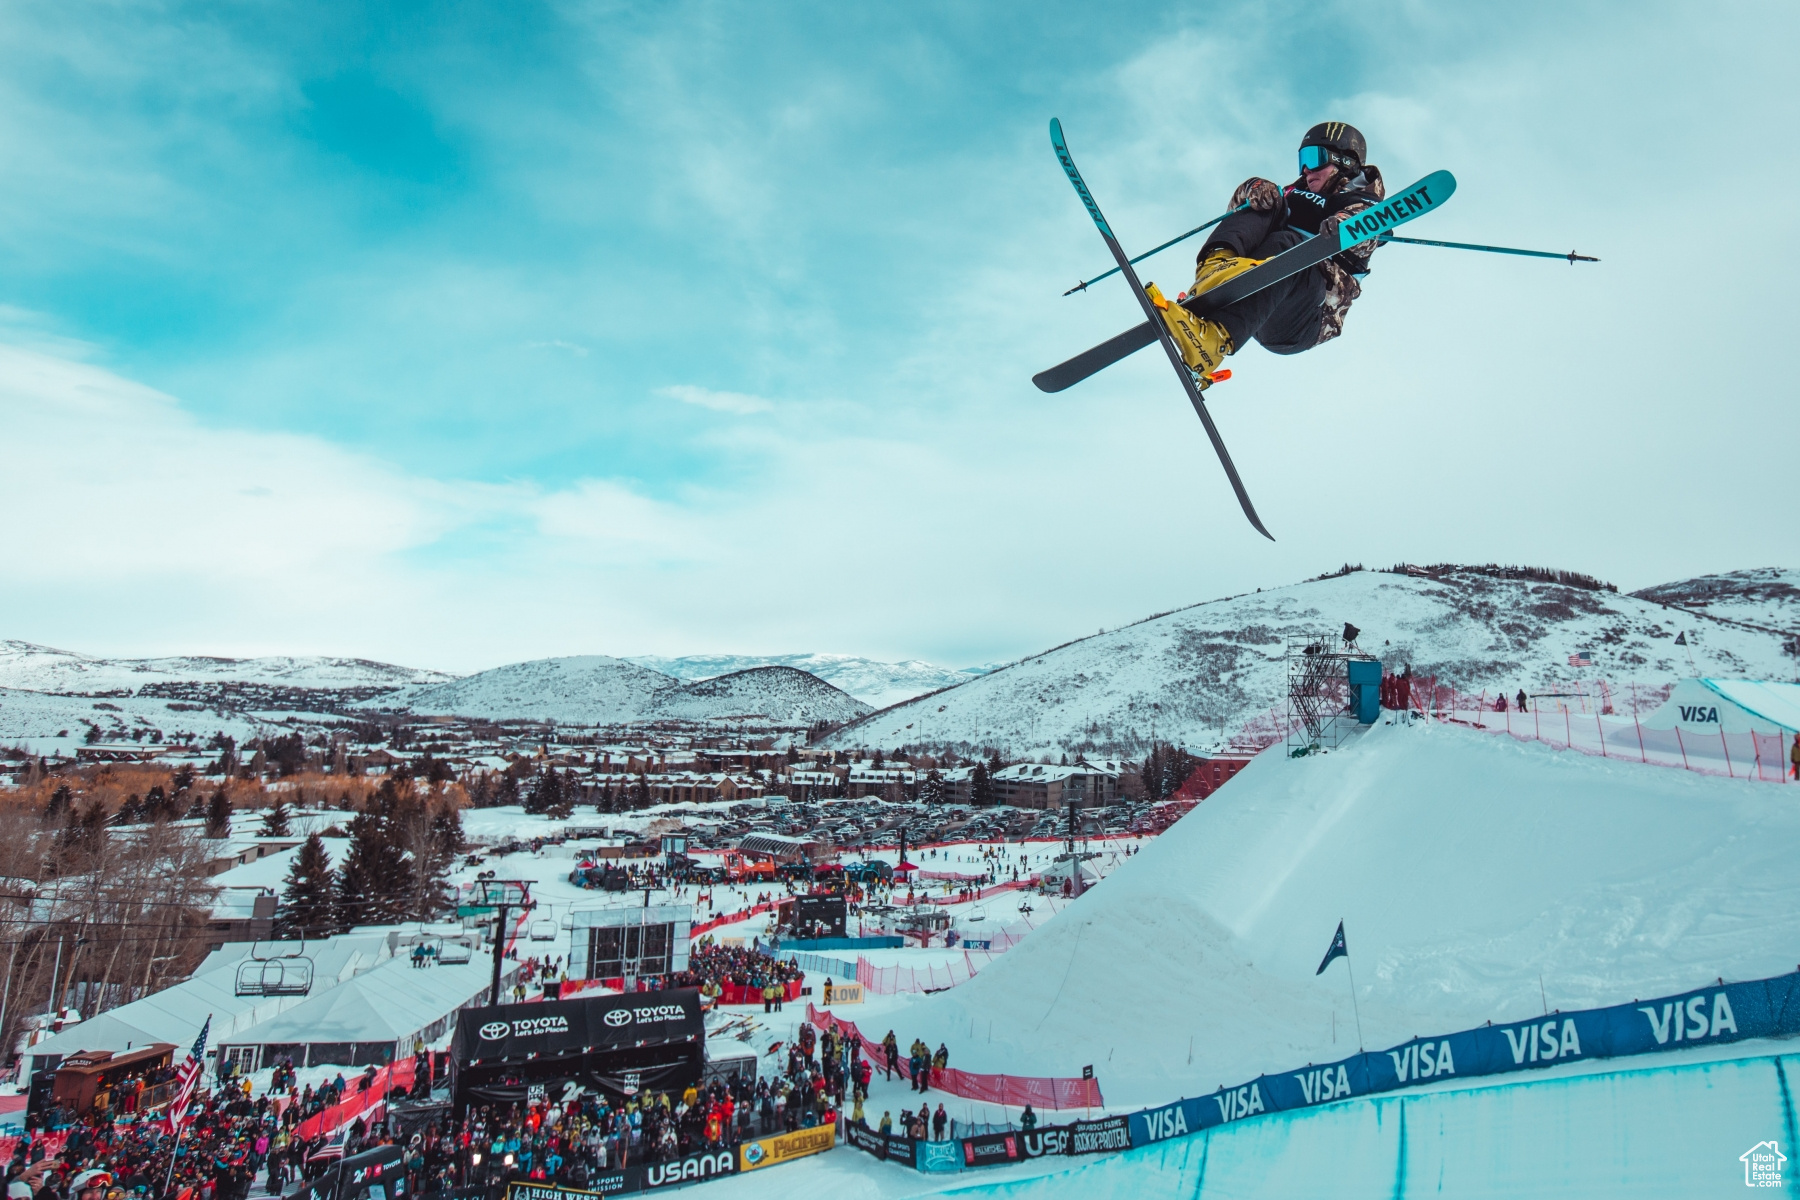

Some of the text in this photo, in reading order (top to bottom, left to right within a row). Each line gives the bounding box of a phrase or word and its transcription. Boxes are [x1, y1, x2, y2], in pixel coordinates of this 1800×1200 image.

[1054, 142, 1103, 223] MOMENT
[1345, 186, 1433, 241] MOMENT
[1177, 320, 1214, 367] FISCHER
[1678, 705, 1719, 723] VISA
[633, 1005, 685, 1017] TOYOTA
[826, 988, 859, 1002] SLOW
[512, 1015, 568, 1031] TOYOTA
[664, 1013, 686, 1021] Places
[1638, 992, 1738, 1045] VISA
[1501, 1018, 1582, 1064] VISA
[1386, 1040, 1455, 1083] VISA
[1294, 1064, 1351, 1104] VISA
[1213, 1083, 1264, 1123] VISA
[1143, 1106, 1188, 1140] VISA
[383, 1158, 401, 1171] TOYOTA
[597, 1175, 624, 1186] SPORTS
[648, 1151, 733, 1186] USANA
[531, 1188, 562, 1200] HIGH
